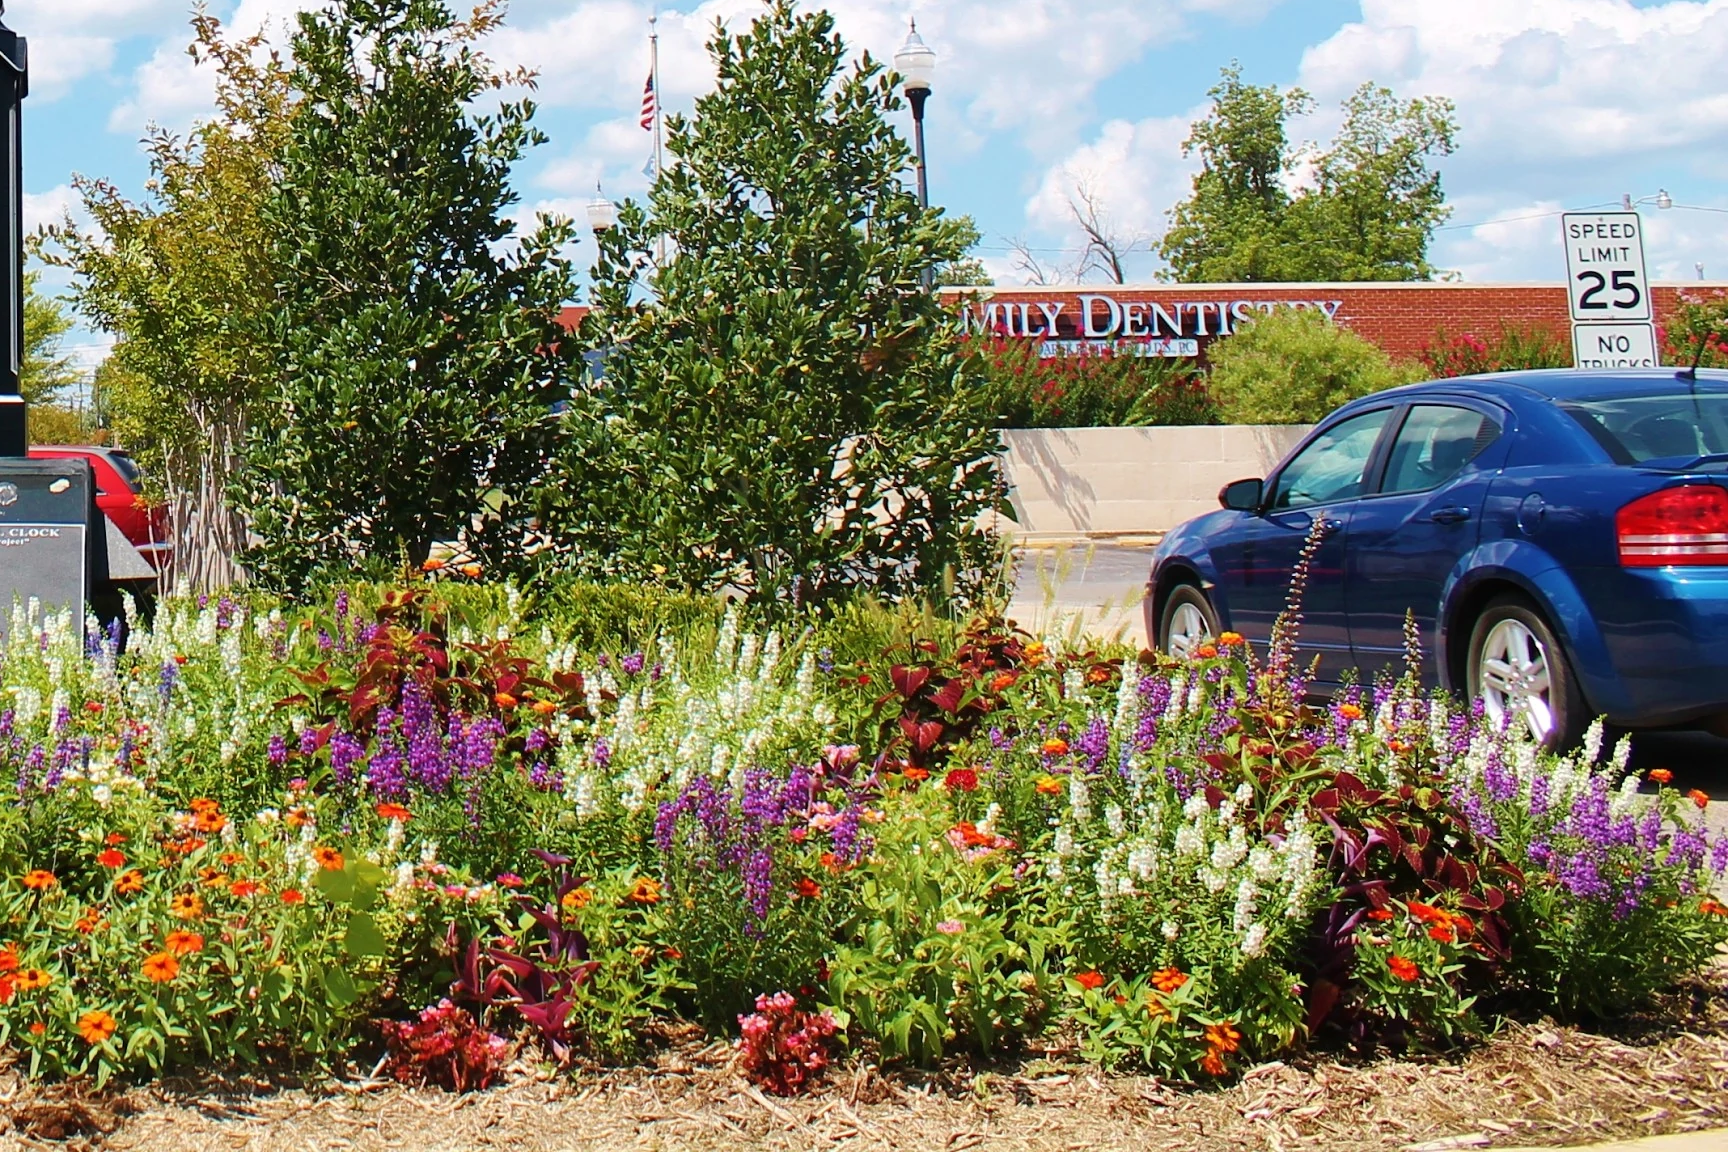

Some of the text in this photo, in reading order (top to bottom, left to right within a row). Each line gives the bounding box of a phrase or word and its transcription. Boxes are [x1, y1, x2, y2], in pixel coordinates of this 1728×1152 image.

[1570, 224, 1636, 239] SPEED
[1578, 247, 1630, 262] LIMIT
[1576, 270, 1641, 310] 25
[962, 301, 1066, 338] MILY
[1597, 335, 1631, 353] NO
[9, 528, 60, 537] CLOCK
